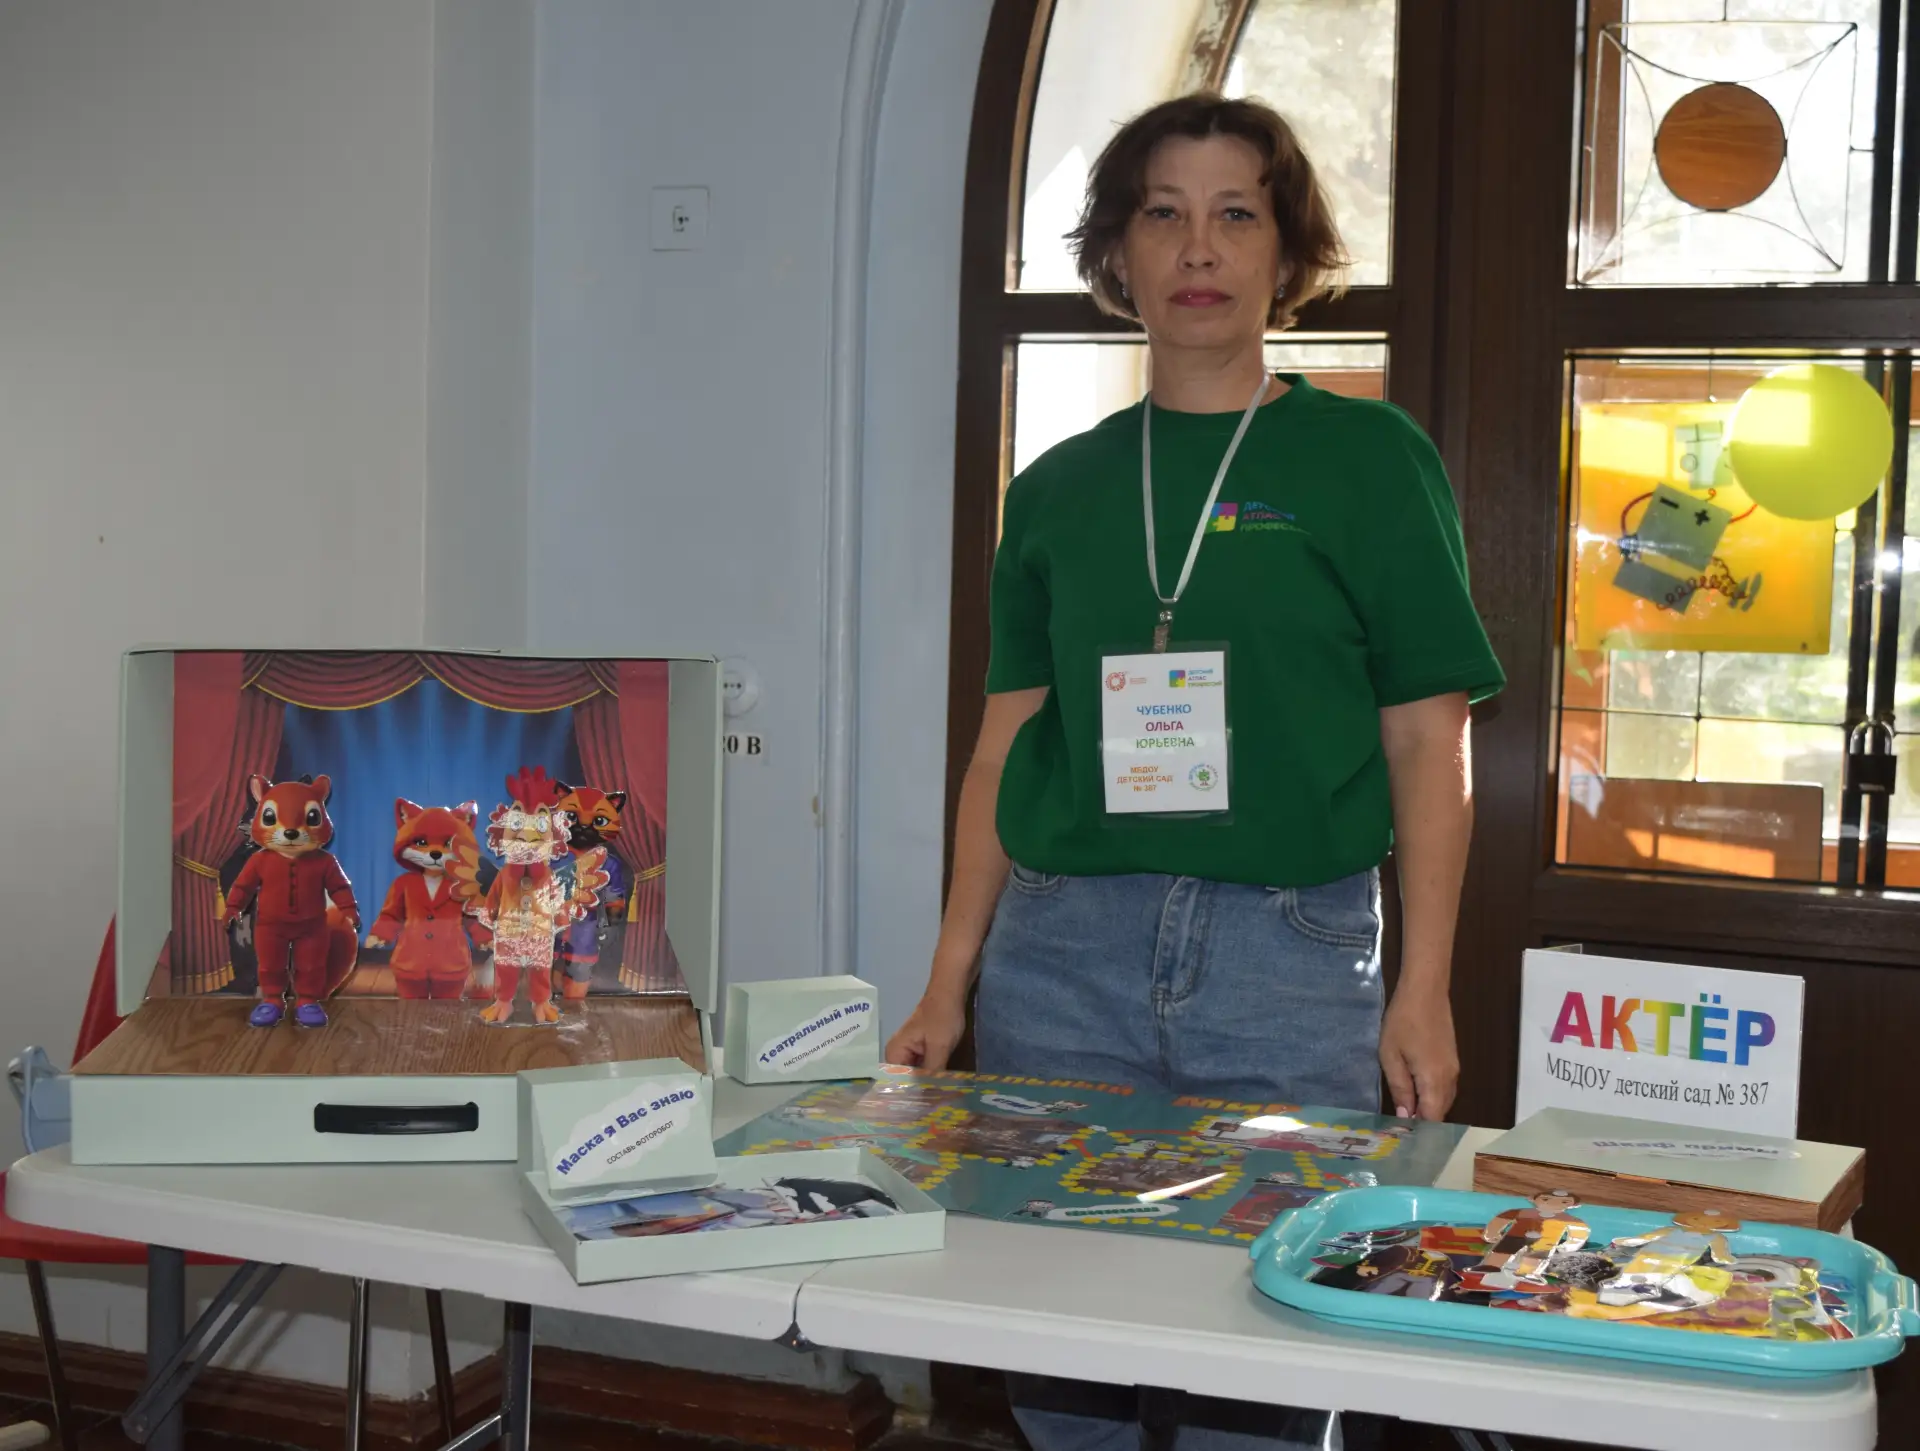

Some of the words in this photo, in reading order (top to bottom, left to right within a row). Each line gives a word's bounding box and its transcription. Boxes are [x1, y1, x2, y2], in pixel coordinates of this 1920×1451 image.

[1240, 522, 1312, 536] ПРОФЕС
[1136, 704, 1192, 716] ЧУБЕНКО
[1145, 720, 1184, 732] ОЛЬГА
[723, 735, 739, 754] 0
[1136, 737, 1195, 749] ЮРЬЕВНА
[1130, 766, 1159, 774] МБДОУ
[1116, 774, 1154, 784] ДЕТСКИЙ
[1155, 775, 1173, 783] САД
[1144, 784, 1157, 792] 387
[759, 1007, 843, 1064] Театральный
[843, 1002, 870, 1016] мир
[1549, 990, 1777, 1067] АКТЁР
[783, 1044, 821, 1068] НАСТОЛЬНАЯ
[820, 1037, 835, 1049] ИГРА
[834, 1023, 861, 1041] ХОДИЛКА
[1546, 1052, 1611, 1090] МБДОУ
[1614, 1077, 1679, 1102] детский
[1683, 1086, 1711, 1106] сад
[1715, 1083, 1735, 1106] №
[1739, 1081, 1770, 1106] 387
[556, 1132, 605, 1175] Маска
[603, 1124, 617, 1139] я
[615, 1106, 648, 1130] Вас
[649, 1088, 695, 1111] знаю
[606, 1144, 636, 1165] СОСТАВЬ
[635, 1120, 675, 1147] ФОТОРОБОТ
